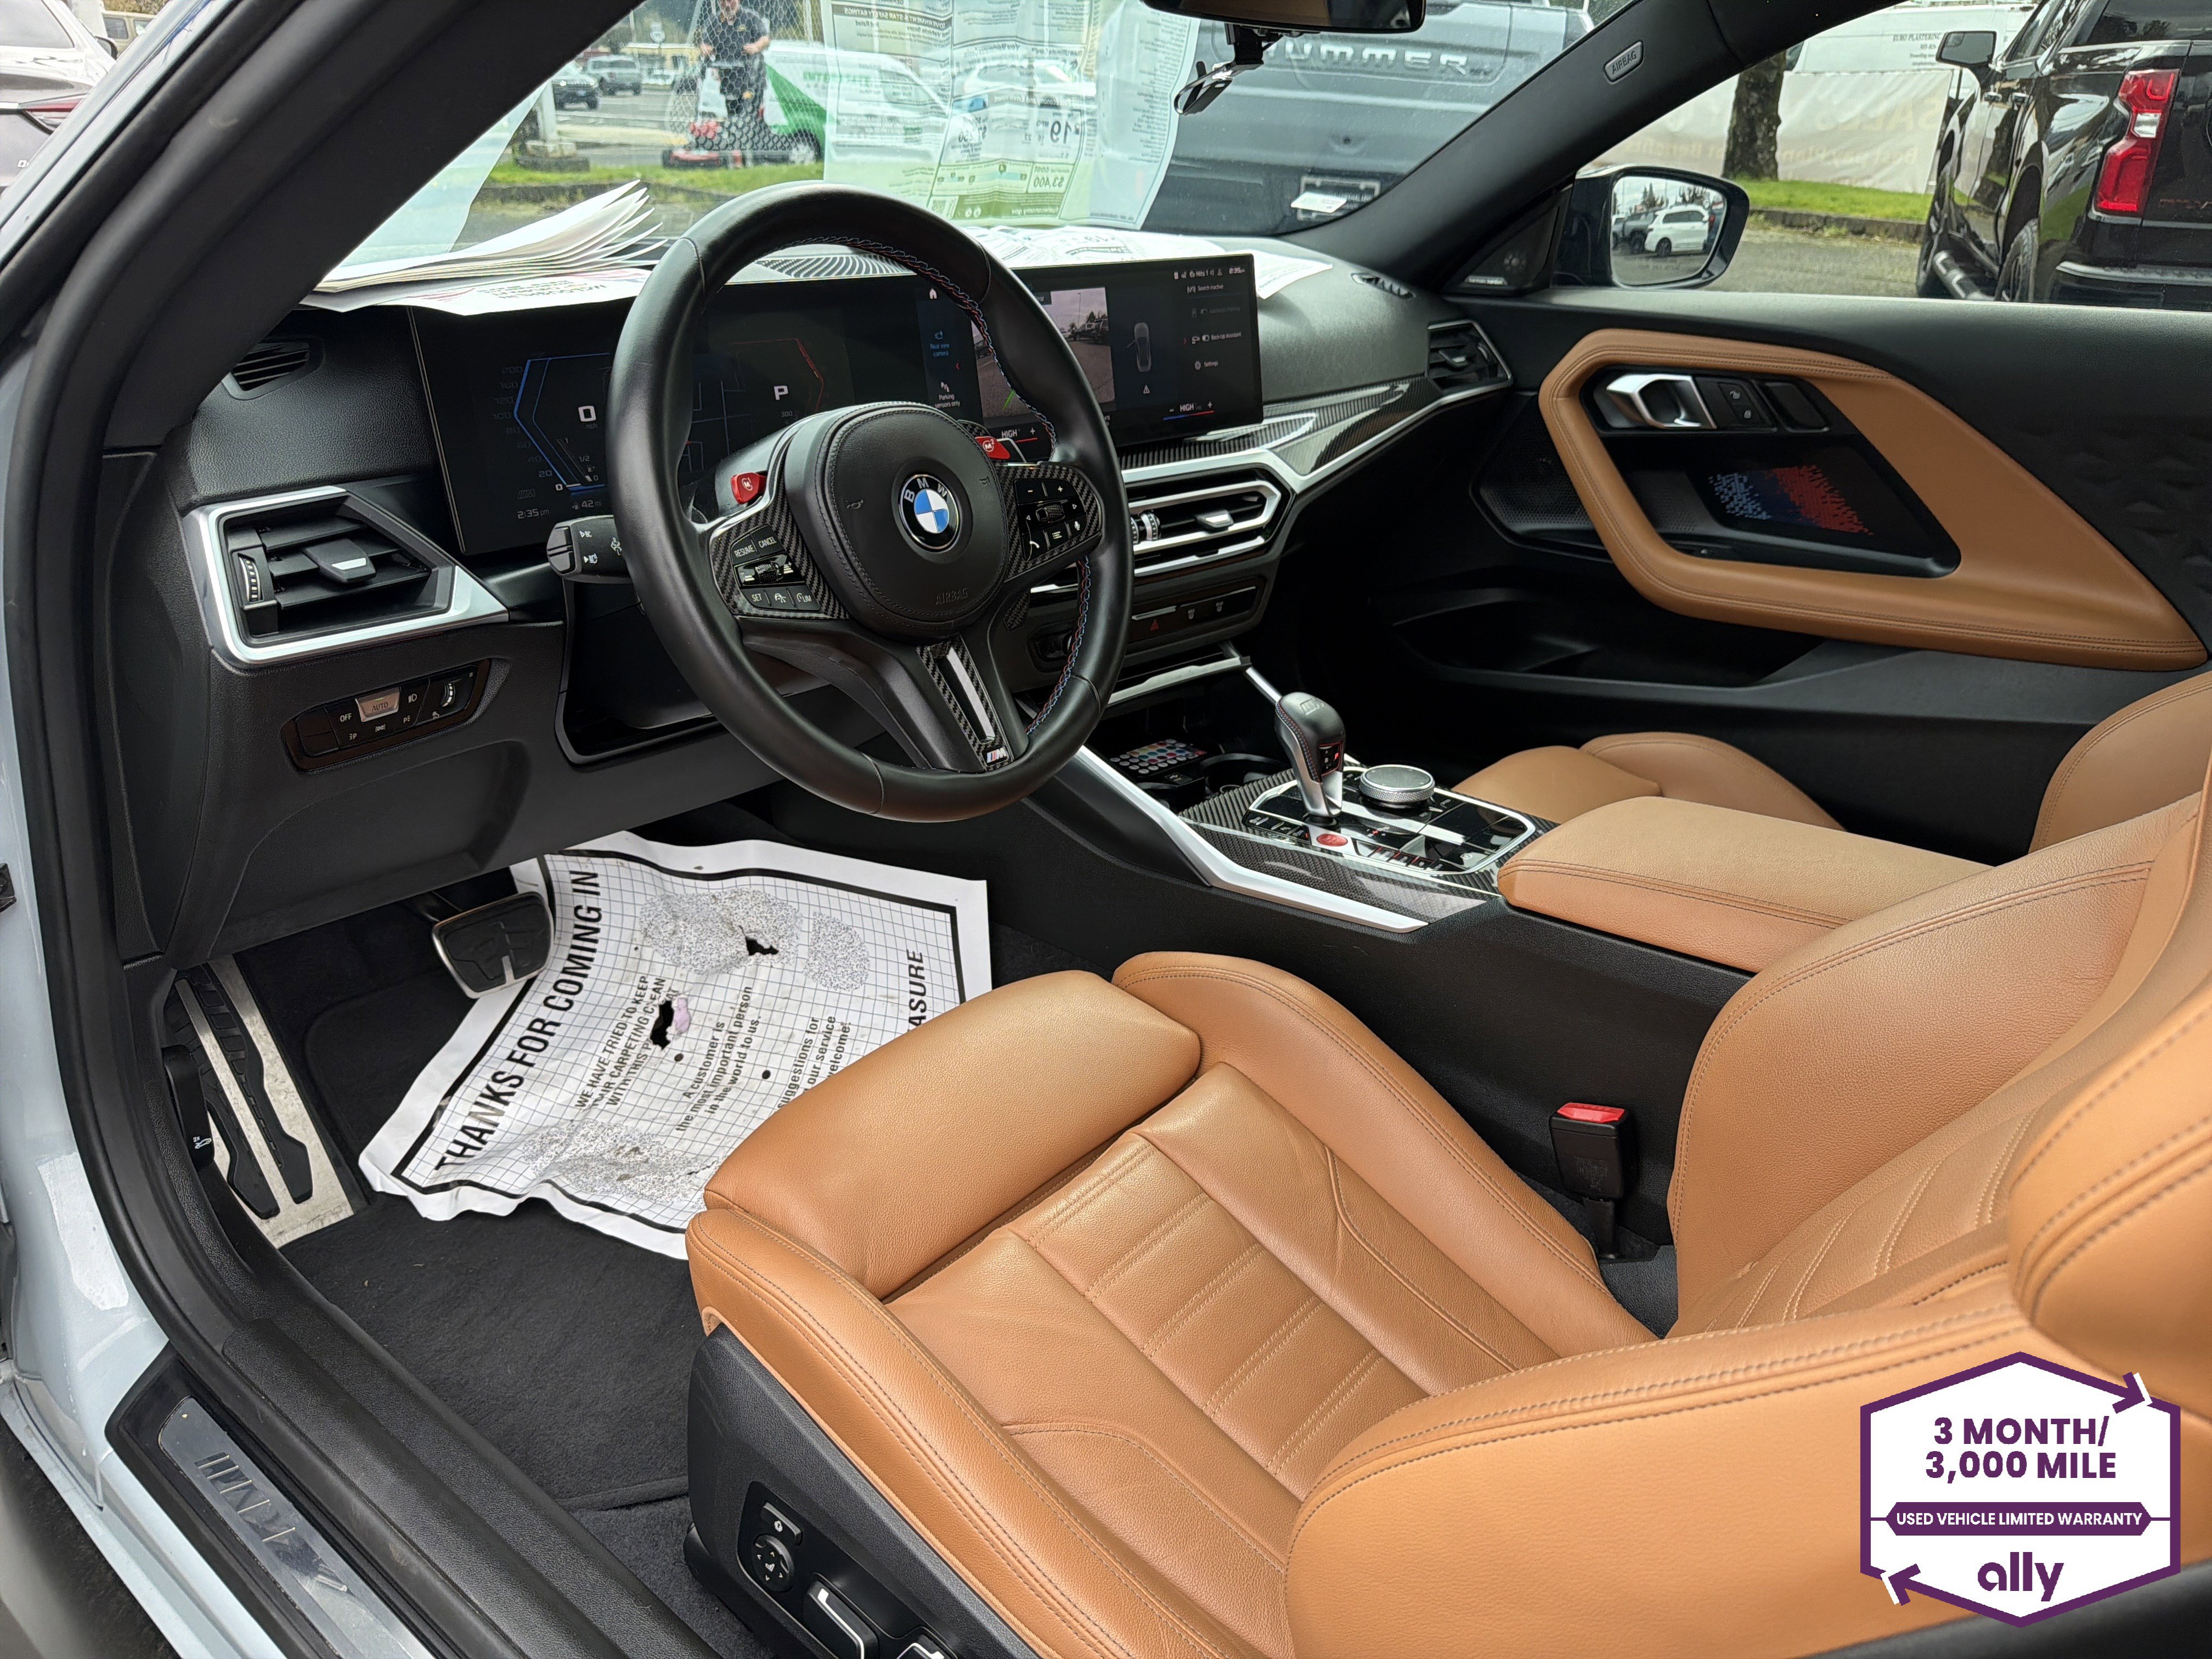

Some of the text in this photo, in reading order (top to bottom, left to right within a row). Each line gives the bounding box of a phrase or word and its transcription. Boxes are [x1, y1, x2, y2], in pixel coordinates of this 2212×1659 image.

[1612, 50, 1637, 74] AIRBAG
[774, 385, 789, 400] P
[578, 405, 596, 422] 0
[1180, 403, 1194, 413] HIGH
[1001, 429, 1018, 438] HIGH
[538, 470, 552, 478] 20
[904, 477, 947, 503] BMW
[517, 508, 539, 519] 2:35
[758, 536, 777, 548] CANCEL
[734, 545, 755, 558] RESUME
[752, 593, 763, 602] SET
[935, 587, 968, 606] AIRBAG
[371, 702, 389, 712] AUTO
[340, 713, 352, 723] OFF
[906, 949, 927, 1032] ASURE
[435, 870, 602, 1171] THANKS FOR COMING IN
[805, 1017, 820, 1035] for
[574, 975, 648, 1108] WE HAVE TRIED TO KEEP
[610, 1016, 650, 1079] CARPETING
[675, 986, 753, 1132] the most important person
[682, 1021, 725, 1098] A customer is
[807, 1016, 836, 1086] our service
[705, 1016, 761, 1114] in the world to us.
[606, 1079, 631, 1106] WITH
[626, 1052, 648, 1076] THIS
